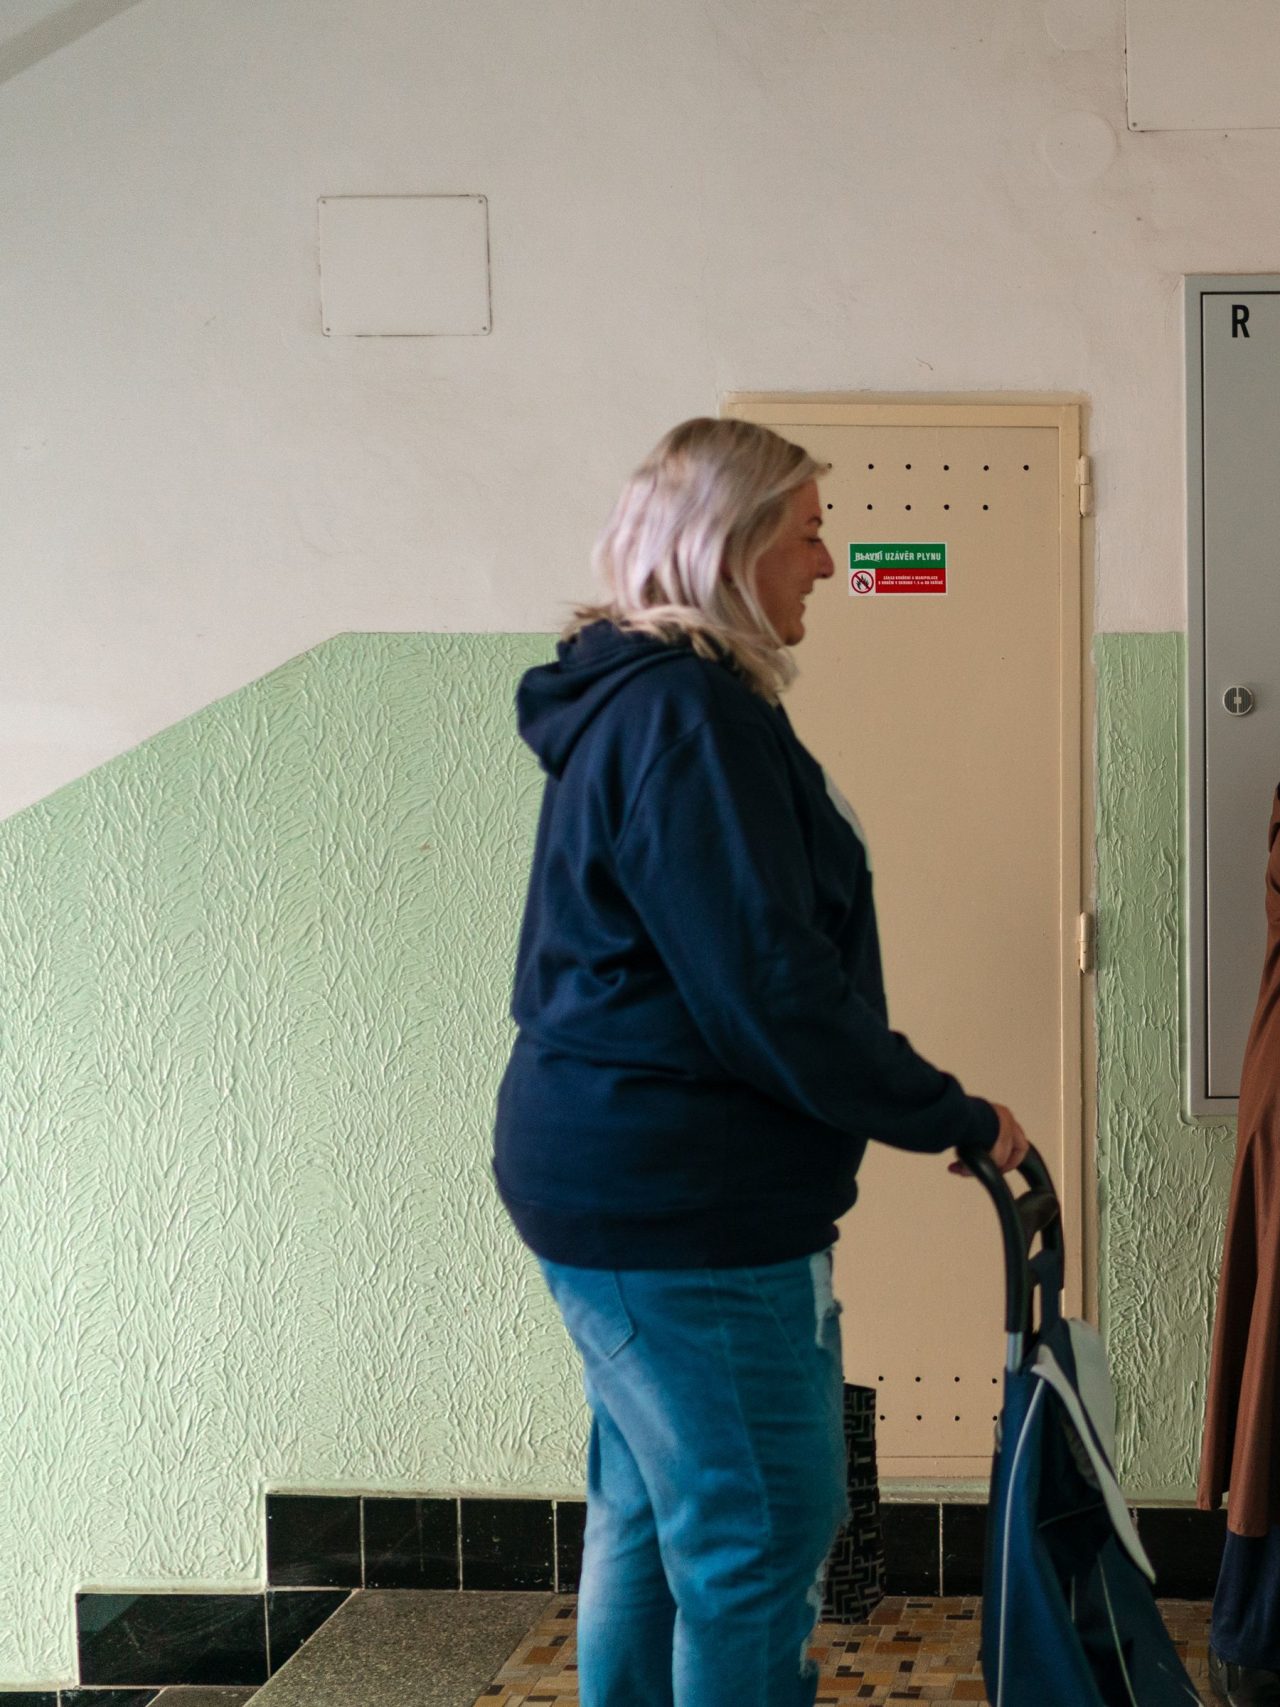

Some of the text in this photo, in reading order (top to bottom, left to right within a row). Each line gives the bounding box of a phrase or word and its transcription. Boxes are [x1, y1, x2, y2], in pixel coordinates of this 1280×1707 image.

[1232, 304, 1250, 338] R
[885, 550, 914, 561] UZÁVĚR
[916, 552, 941, 561] PLYNU
